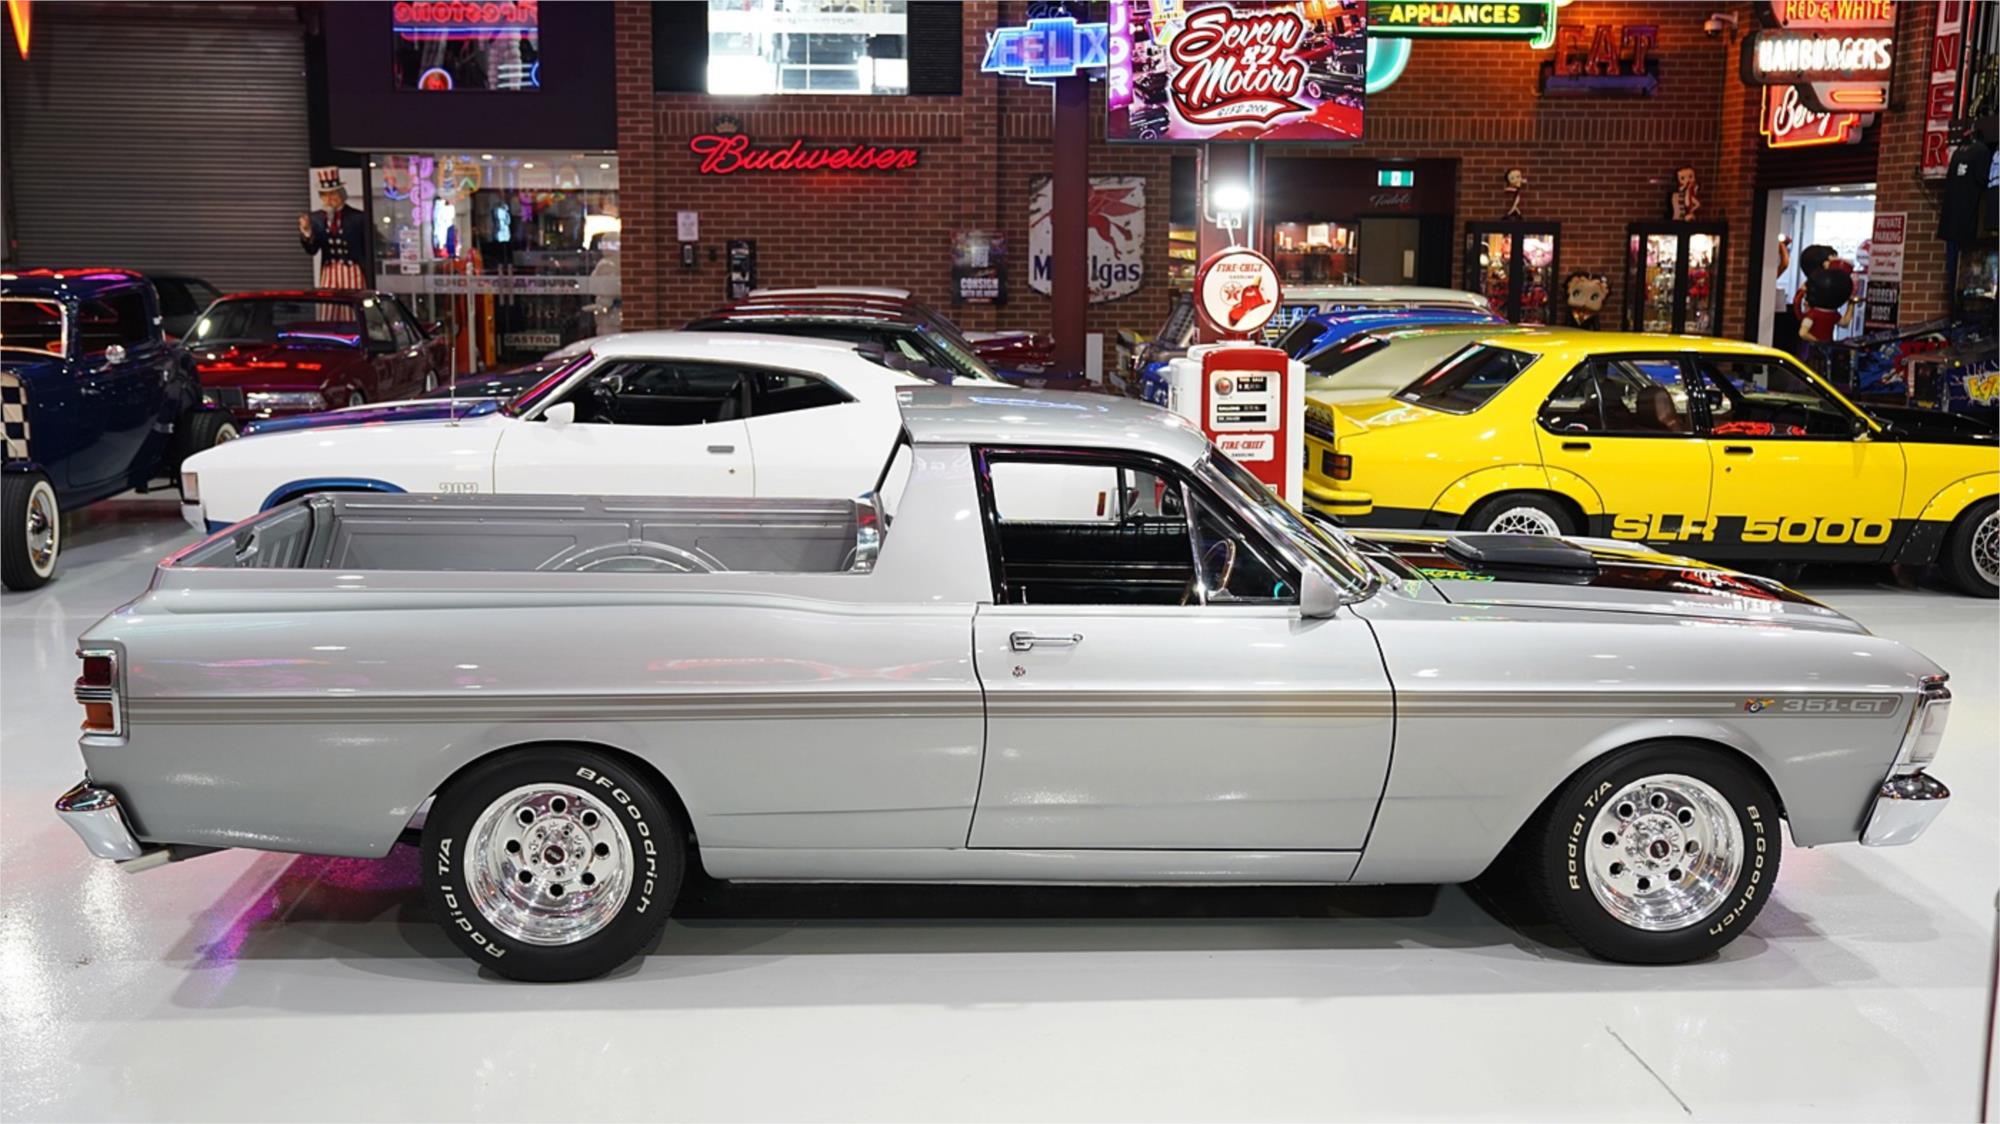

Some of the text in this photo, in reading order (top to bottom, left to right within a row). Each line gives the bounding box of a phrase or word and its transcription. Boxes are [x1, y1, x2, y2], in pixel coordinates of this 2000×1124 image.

[1388, 4, 1521, 24] APPLIANCES
[1786, 1, 1891, 20] RED & WHITE
[999, 28, 1107, 66] FELIX
[1176, 10, 1297, 62] Seven
[1554, 25, 1659, 76] EAT
[1240, 45, 1277, 65] 82
[1758, 38, 1892, 72] HAMBURGERS
[1180, 55, 1296, 105] Motors
[690, 135, 918, 174] Budweiser
[1033, 255, 1141, 289] Mlgas
[505, 335, 558, 346] CASTROL
[1221, 441, 1266, 450] FIRE-CHIEF
[1611, 514, 1893, 545] SLR 5000
[1781, 698, 1890, 713] 351-GT
[576, 766, 658, 914] BFGoodrich
[1568, 780, 1613, 890] Radial T/A
[1708, 805, 1767, 936] BFGoodrich
[437, 838, 506, 958] Radial T/A
